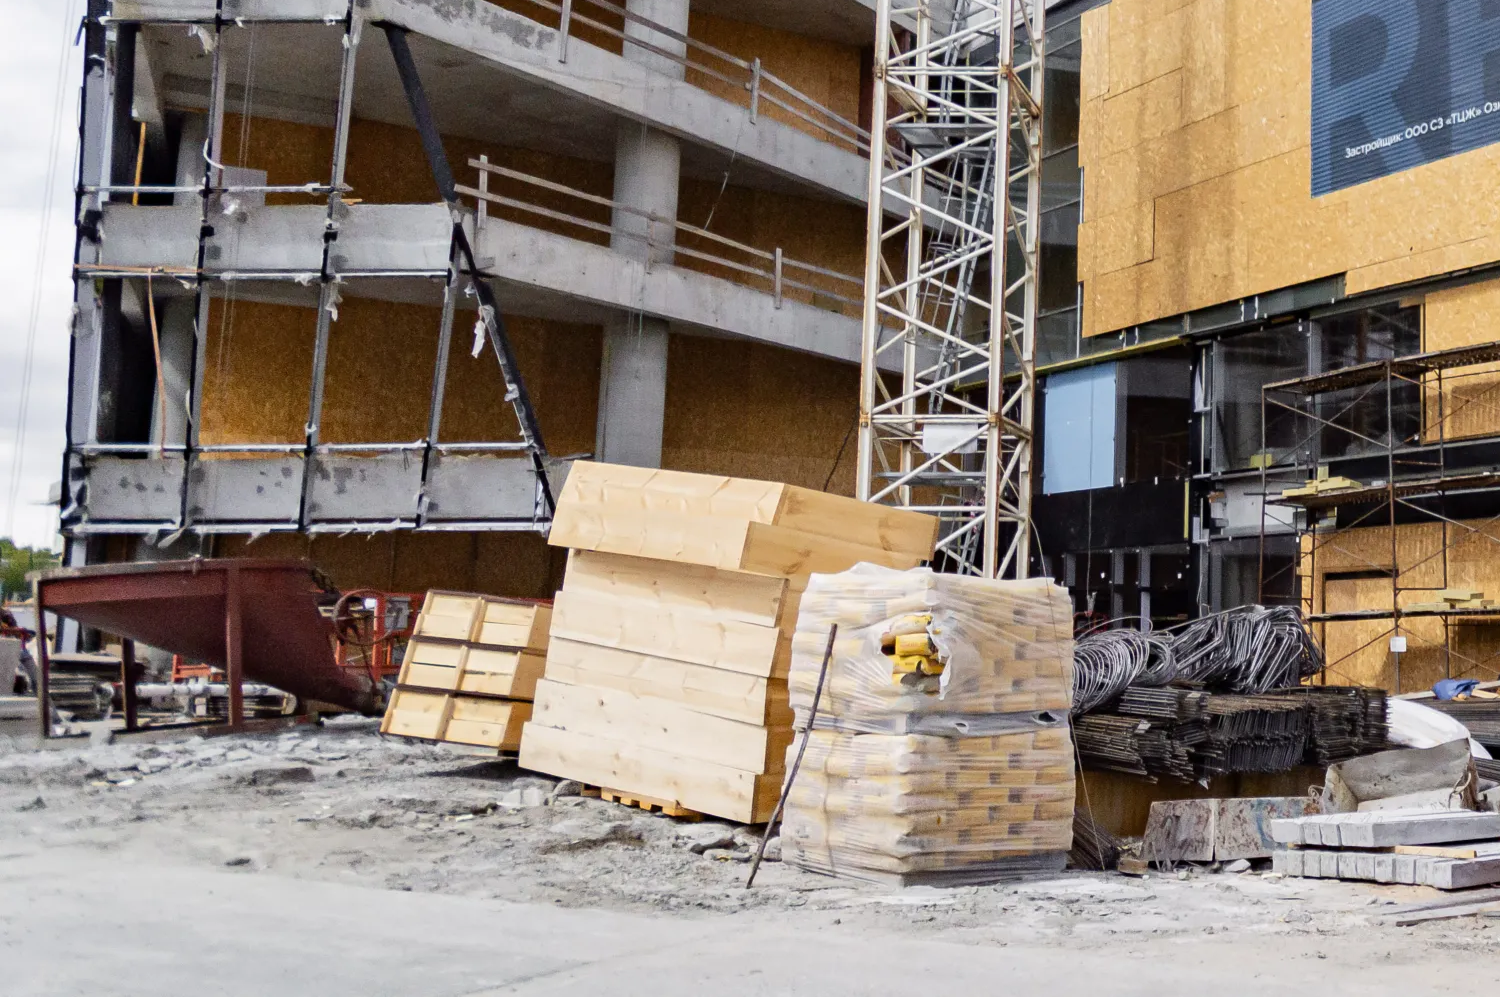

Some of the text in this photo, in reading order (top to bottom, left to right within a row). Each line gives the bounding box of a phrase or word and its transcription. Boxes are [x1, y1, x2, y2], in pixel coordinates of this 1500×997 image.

[1345, 132, 1405, 159] Застройщик:
[1405, 121, 1429, 140] ООО
[1430, 117, 1444, 131] СЗ
[1446, 107, 1482, 126] «ТЦЖ»
